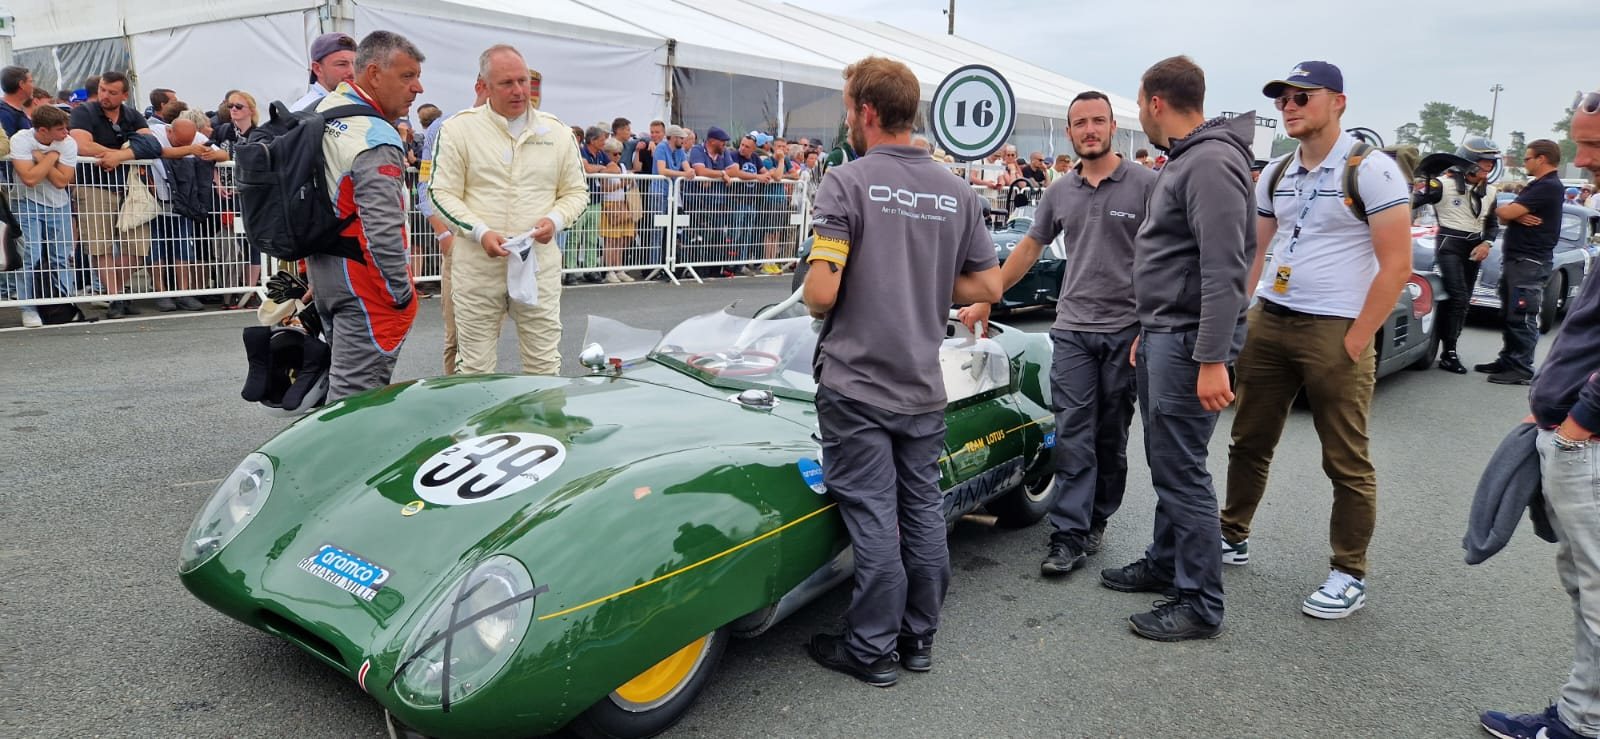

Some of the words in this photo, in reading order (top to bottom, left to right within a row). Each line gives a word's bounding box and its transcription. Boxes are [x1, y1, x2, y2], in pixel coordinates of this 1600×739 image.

[953, 99, 994, 128] 16
[440, 447, 461, 457] 2
[966, 437, 985, 453] TEAM
[986, 429, 1006, 445] LOTUS
[420, 434, 559, 500] 39
[296, 557, 342, 585] RICHARD
[321, 551, 374, 582] aramco
